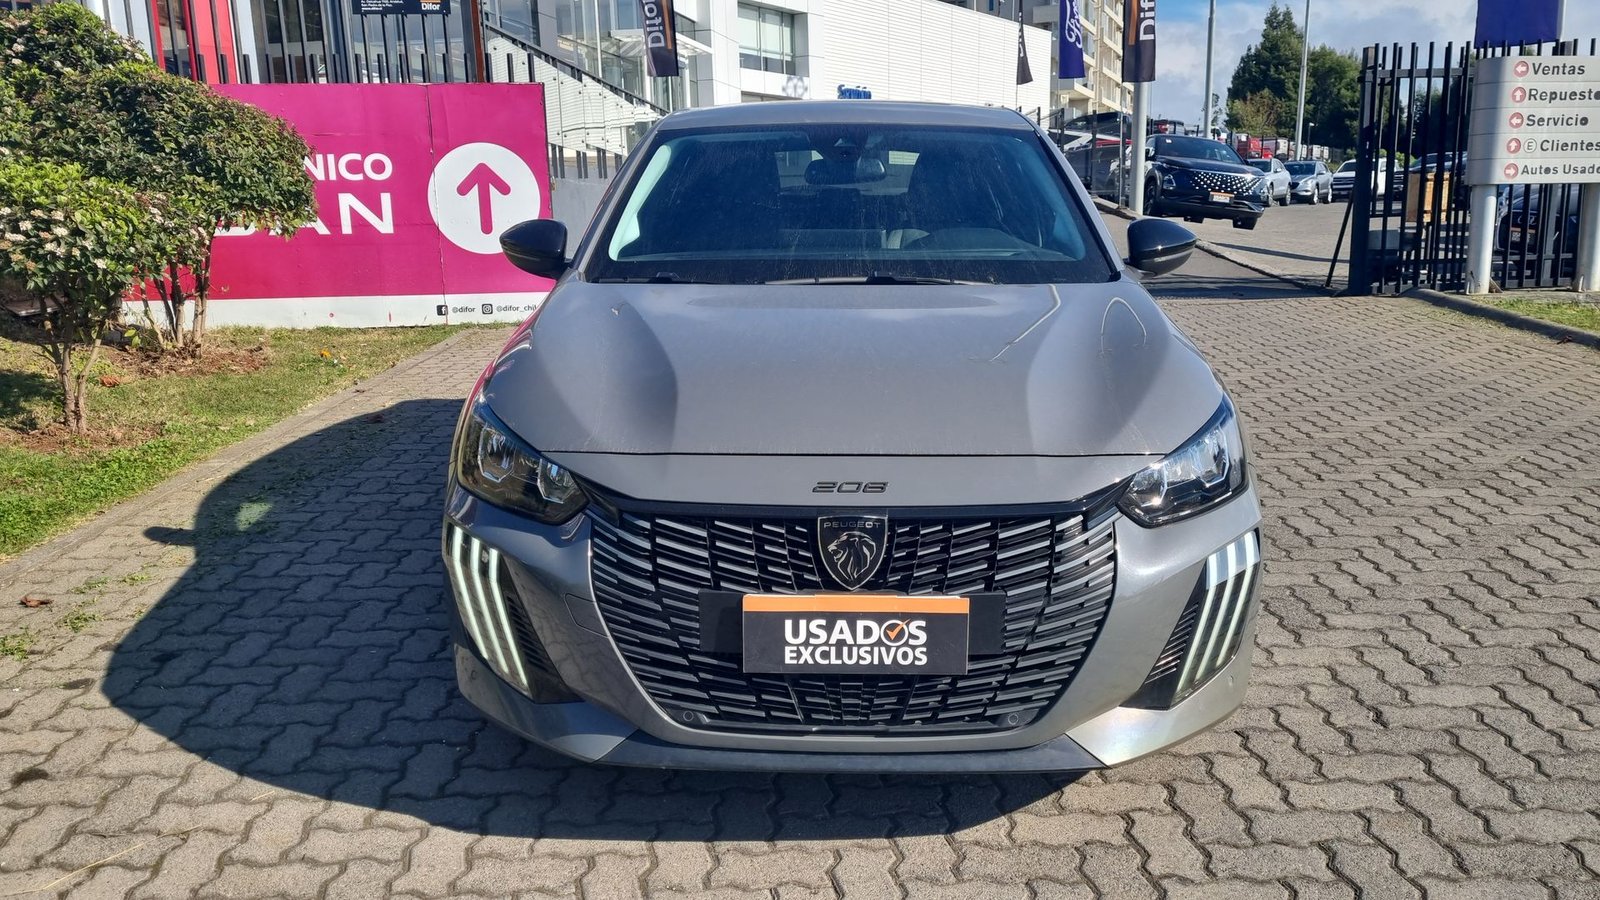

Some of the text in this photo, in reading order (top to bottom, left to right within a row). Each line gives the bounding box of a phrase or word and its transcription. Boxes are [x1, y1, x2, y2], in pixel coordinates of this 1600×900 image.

[1532, 62, 1586, 75] Ventas
[1526, 114, 1589, 127] Servicio
[1540, 140, 1600, 152] Clientes
[1521, 164, 1559, 175] Autos
[812, 481, 889, 493] 208
[784, 618, 928, 647] USADOS
[784, 646, 928, 665] EXCLUSIVOS
